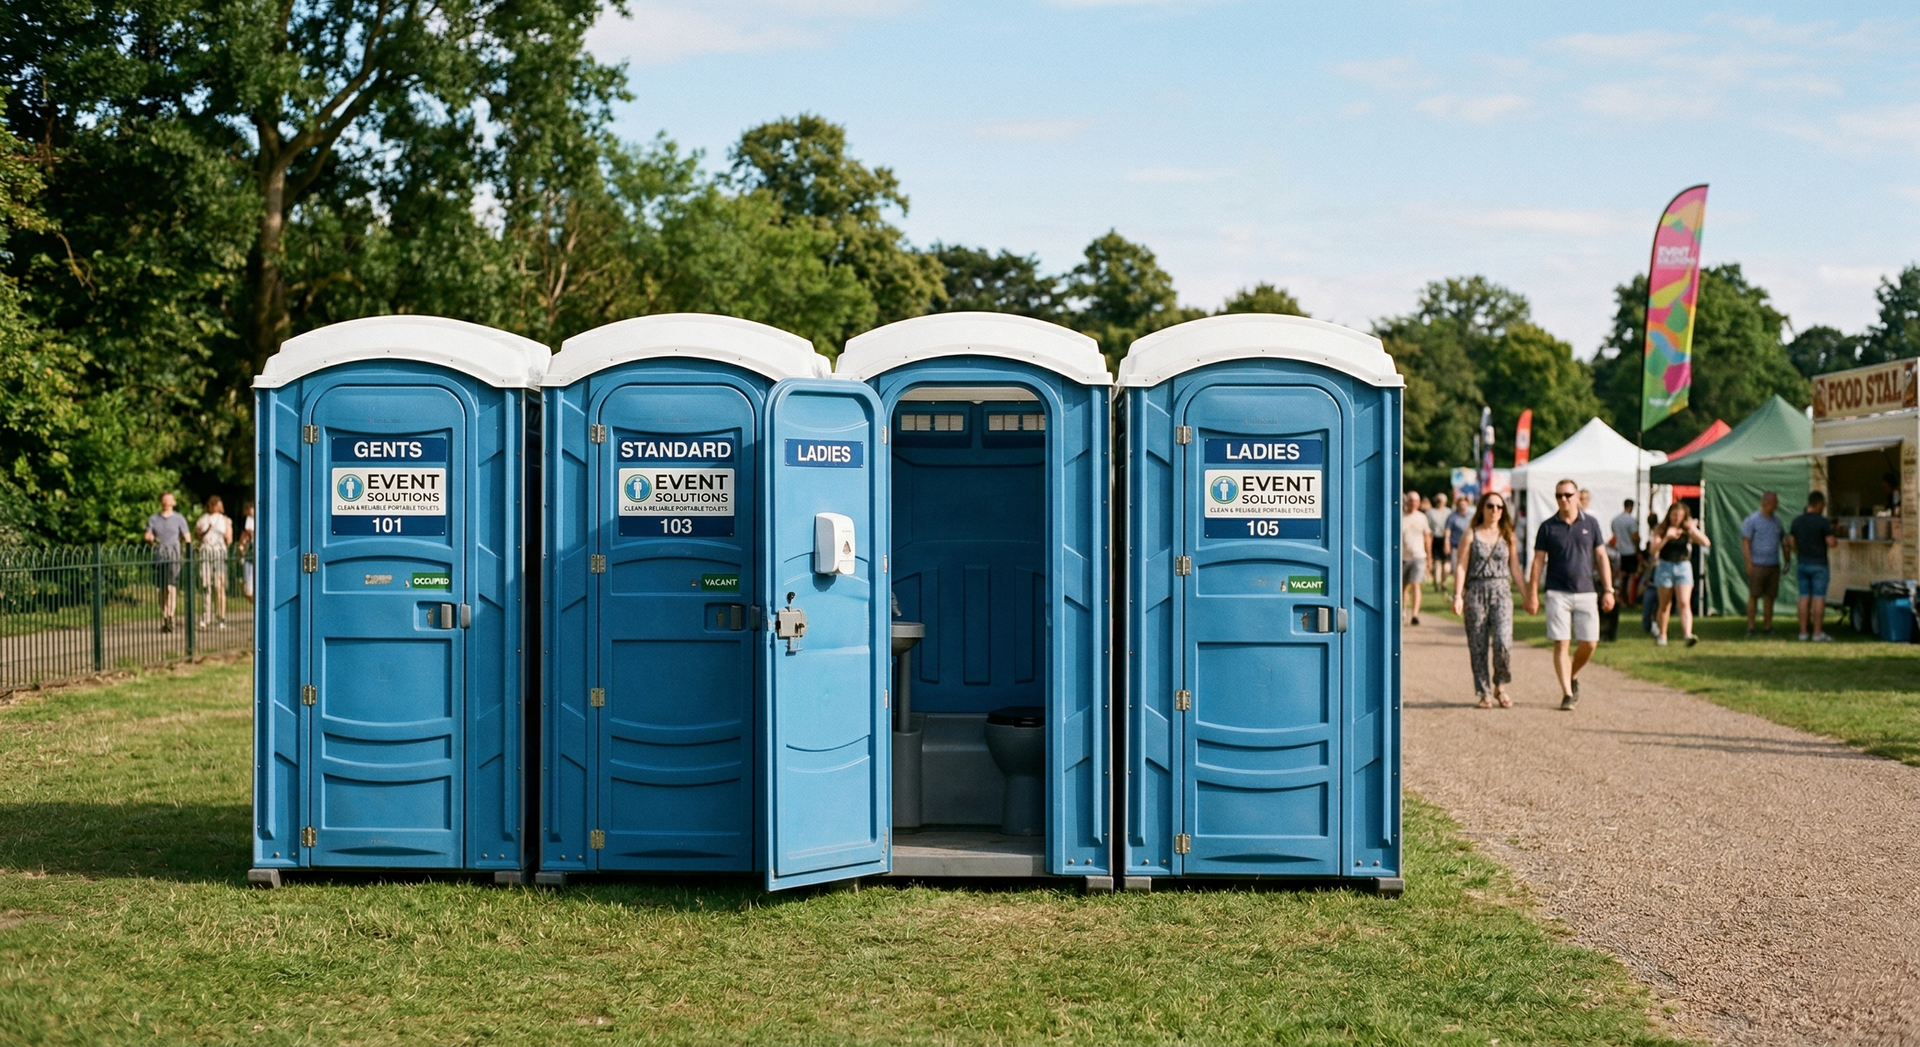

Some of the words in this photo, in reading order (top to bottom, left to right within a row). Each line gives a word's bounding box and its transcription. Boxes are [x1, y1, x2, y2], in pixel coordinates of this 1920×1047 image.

[1828, 378, 1863, 411] FOOD
[353, 441, 423, 458] GENTS
[621, 441, 731, 458] STANDARD
[797, 444, 851, 463] LADIES
[1226, 443, 1300, 460] LADIES
[367, 474, 440, 490] EVENT
[656, 474, 728, 490] EVENT
[1242, 476, 1315, 492] EVENT
[367, 492, 440, 502] SOLUTIONS
[655, 493, 728, 502] SOLUTIONS
[1242, 495, 1315, 504] SOLUTIONS
[372, 518, 402, 533] 101
[660, 518, 692, 534] 103
[1247, 520, 1279, 536] 105
[1290, 581, 1323, 589] VACANT
